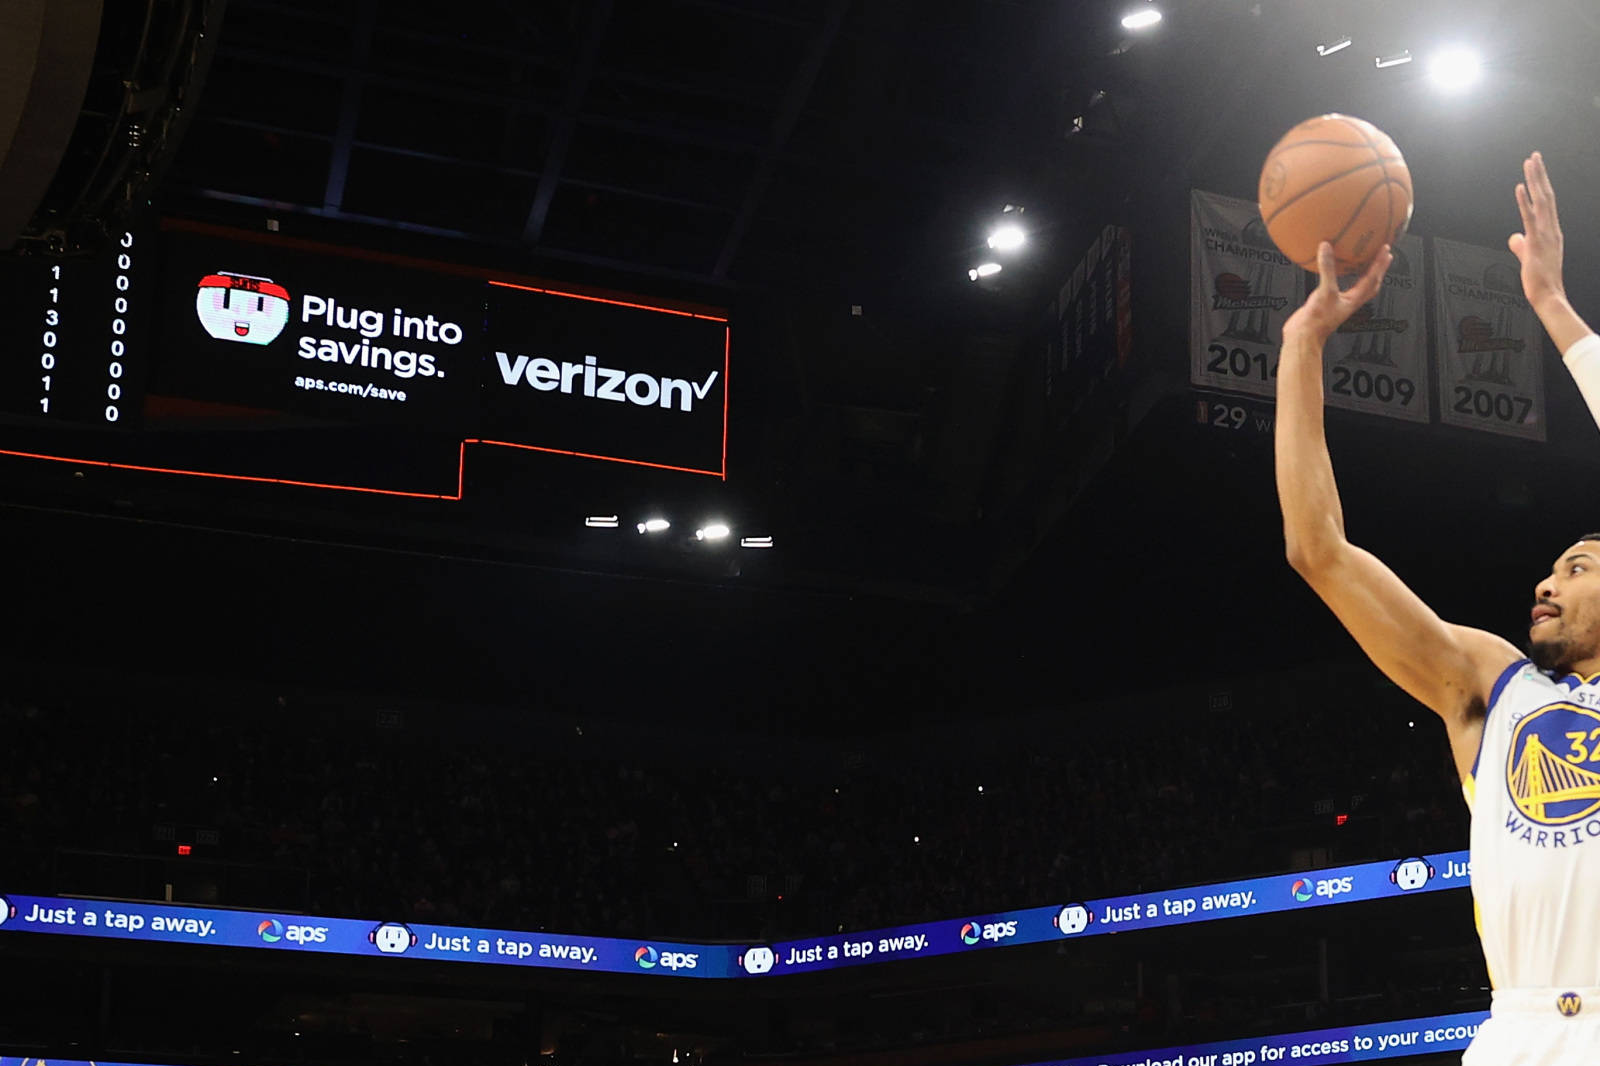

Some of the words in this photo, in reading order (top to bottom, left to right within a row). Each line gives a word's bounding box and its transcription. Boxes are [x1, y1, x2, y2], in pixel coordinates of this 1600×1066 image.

[118, 254, 131, 270] 0
[1206, 239, 1293, 267] CHAMPIONS
[51, 265, 60, 280] 1
[116, 275, 129, 291] 0
[49, 287, 58, 303] 1
[115, 297, 128, 313] 0
[46, 309, 58, 326] 3
[112, 318, 126, 335] 0
[302, 294, 384, 338] Plug
[393, 308, 463, 345] into
[43, 331, 57, 348] 0
[111, 340, 125, 357] 0
[297, 336, 445, 378] savings.
[41, 353, 55, 369] 0
[109, 362, 123, 378] 0
[42, 375, 51, 391] 1
[107, 383, 121, 400] 0
[294, 376, 407, 402] aps.com/save
[495, 351, 693, 412] verizon
[1332, 366, 1415, 407] 2009
[40, 397, 49, 413] 1
[105, 405, 119, 421] 0
[1213, 403, 1247, 430] 29
[1454, 386, 1533, 425] 2007
[1442, 860, 1472, 879] Jus
[1316, 876, 1354, 899] aps
[24, 904, 77, 925] Just
[82, 911, 97, 926] a
[104, 910, 145, 932] tap
[151, 916, 216, 937] away.
[1100, 903, 1141, 924] Just
[1146, 903, 1158, 918] a
[1163, 898, 1197, 917] tap
[1201, 891, 1257, 911] away.
[285, 925, 329, 945] aps
[982, 920, 1018, 942] aps
[424, 932, 471, 952] Just
[477, 939, 490, 953] a
[496, 938, 533, 959] tap
[538, 941, 599, 964] away.
[659, 951, 699, 971] aps
[785, 945, 823, 965] Just
[827, 945, 838, 960] a
[843, 941, 874, 959] tap
[878, 934, 929, 953] away.
[1260, 1045, 1286, 1062] for
[1290, 1039, 1349, 1058] access
[1353, 1035, 1373, 1051] to
[1377, 1031, 1419, 1051] your
[1423, 1025, 1478, 1043] accou
